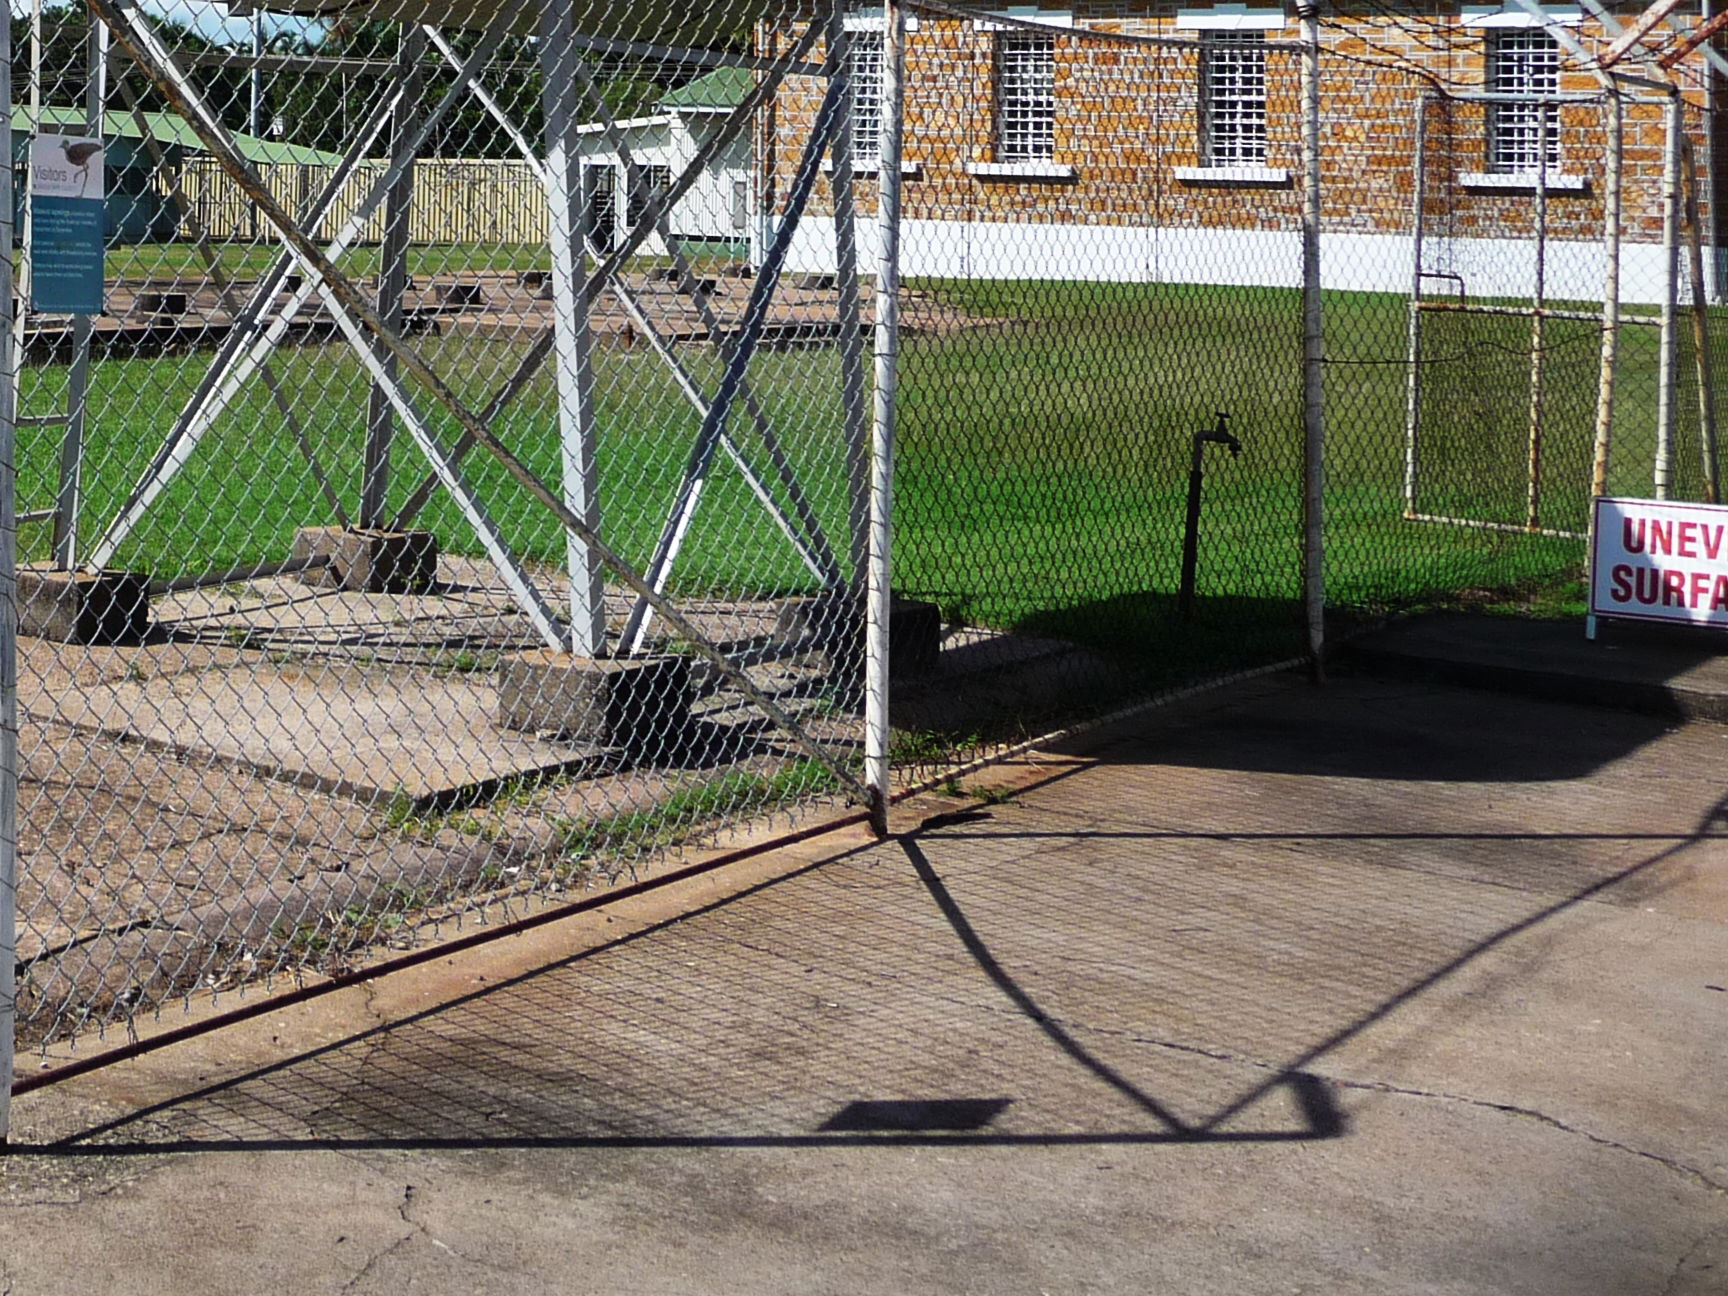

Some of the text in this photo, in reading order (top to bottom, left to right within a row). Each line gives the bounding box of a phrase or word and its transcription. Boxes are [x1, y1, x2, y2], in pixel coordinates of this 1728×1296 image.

[33, 165, 67, 182] Visitors
[1623, 517, 1728, 560] UNEV
[1611, 564, 1728, 611] SURFA
